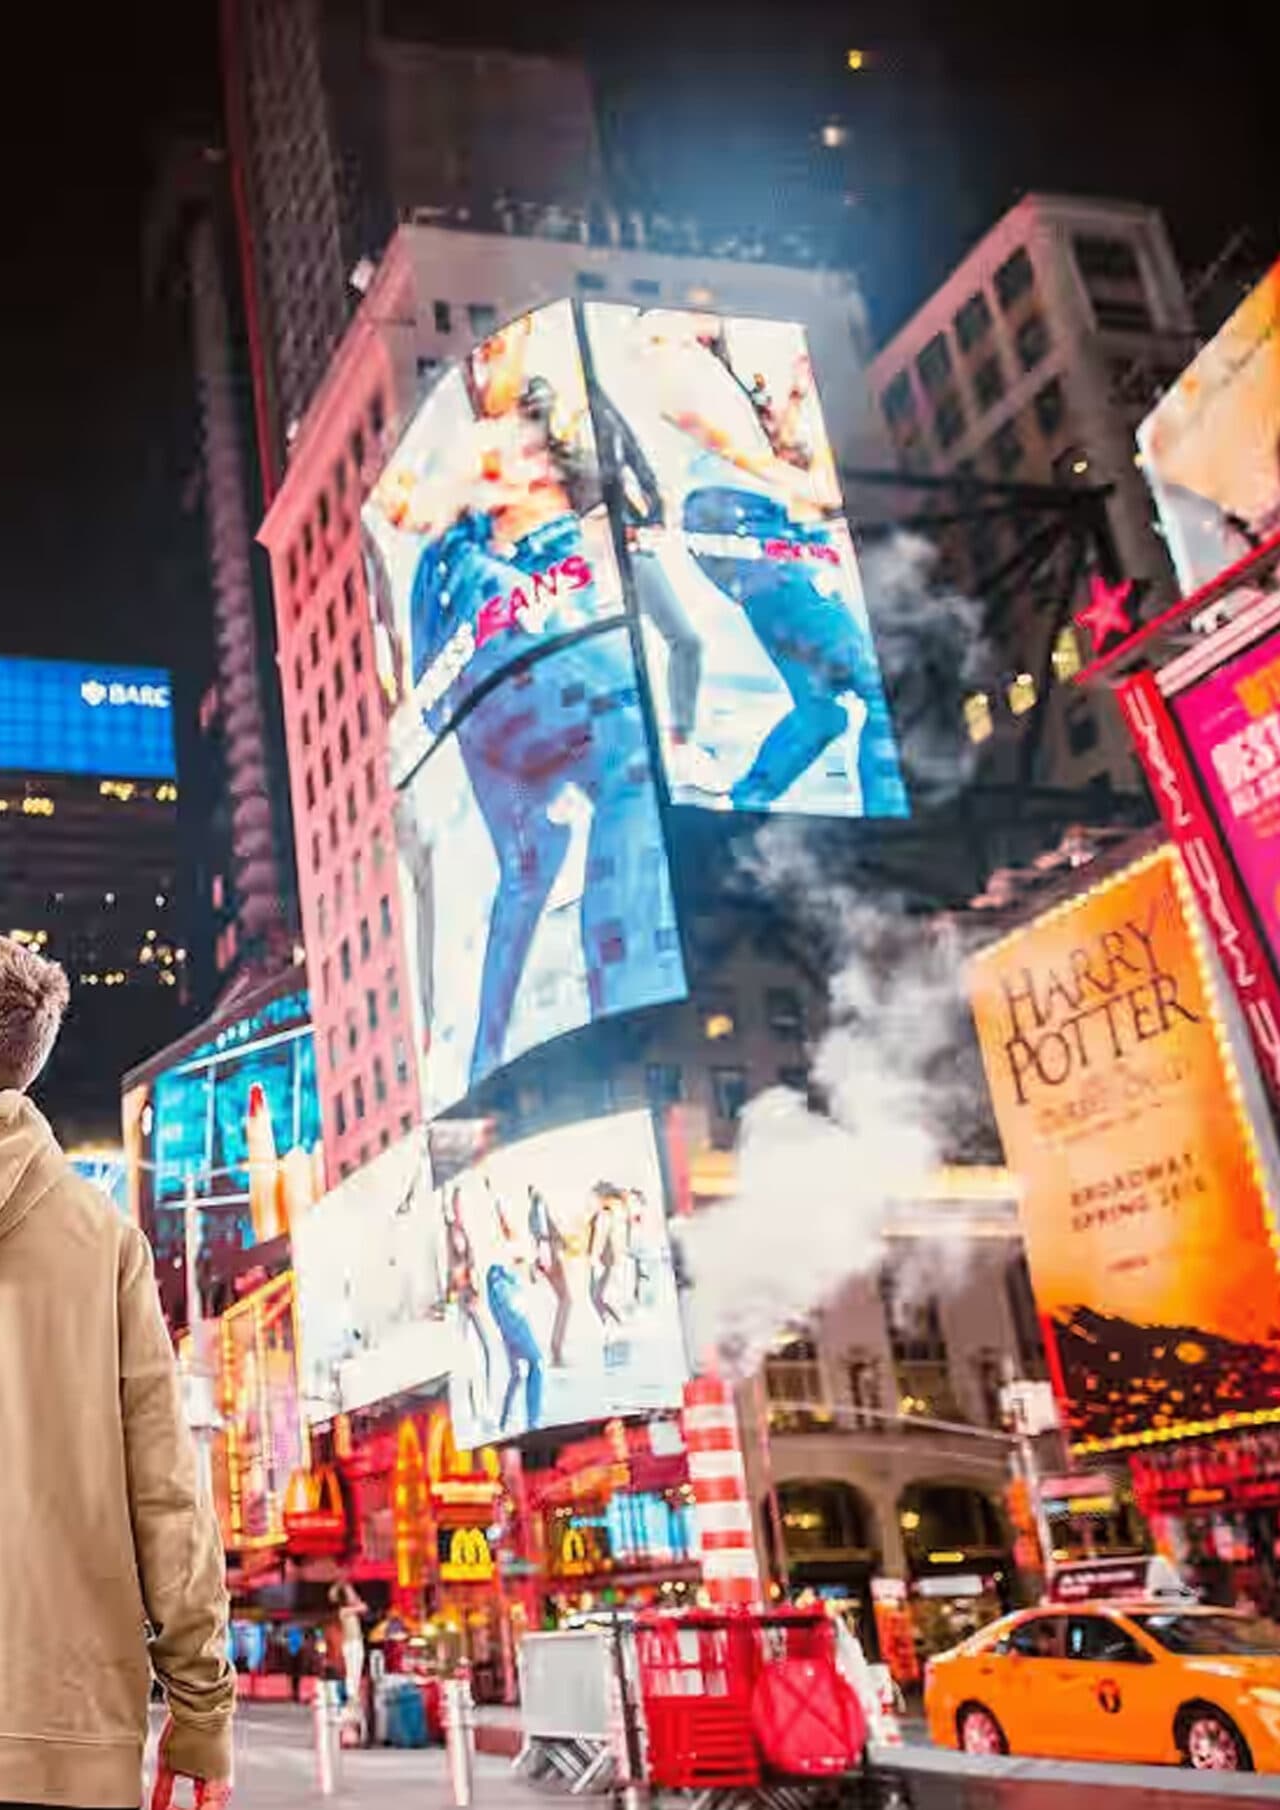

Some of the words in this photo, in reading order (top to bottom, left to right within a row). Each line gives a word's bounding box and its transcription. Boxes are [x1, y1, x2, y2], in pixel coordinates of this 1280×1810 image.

[1000, 905, 1163, 1038] HARRY
[1005, 972, 1200, 1106] POTTER
[1070, 1193, 1150, 1232] SPRING
[1071, 1152, 1193, 1208] BROADWAY
